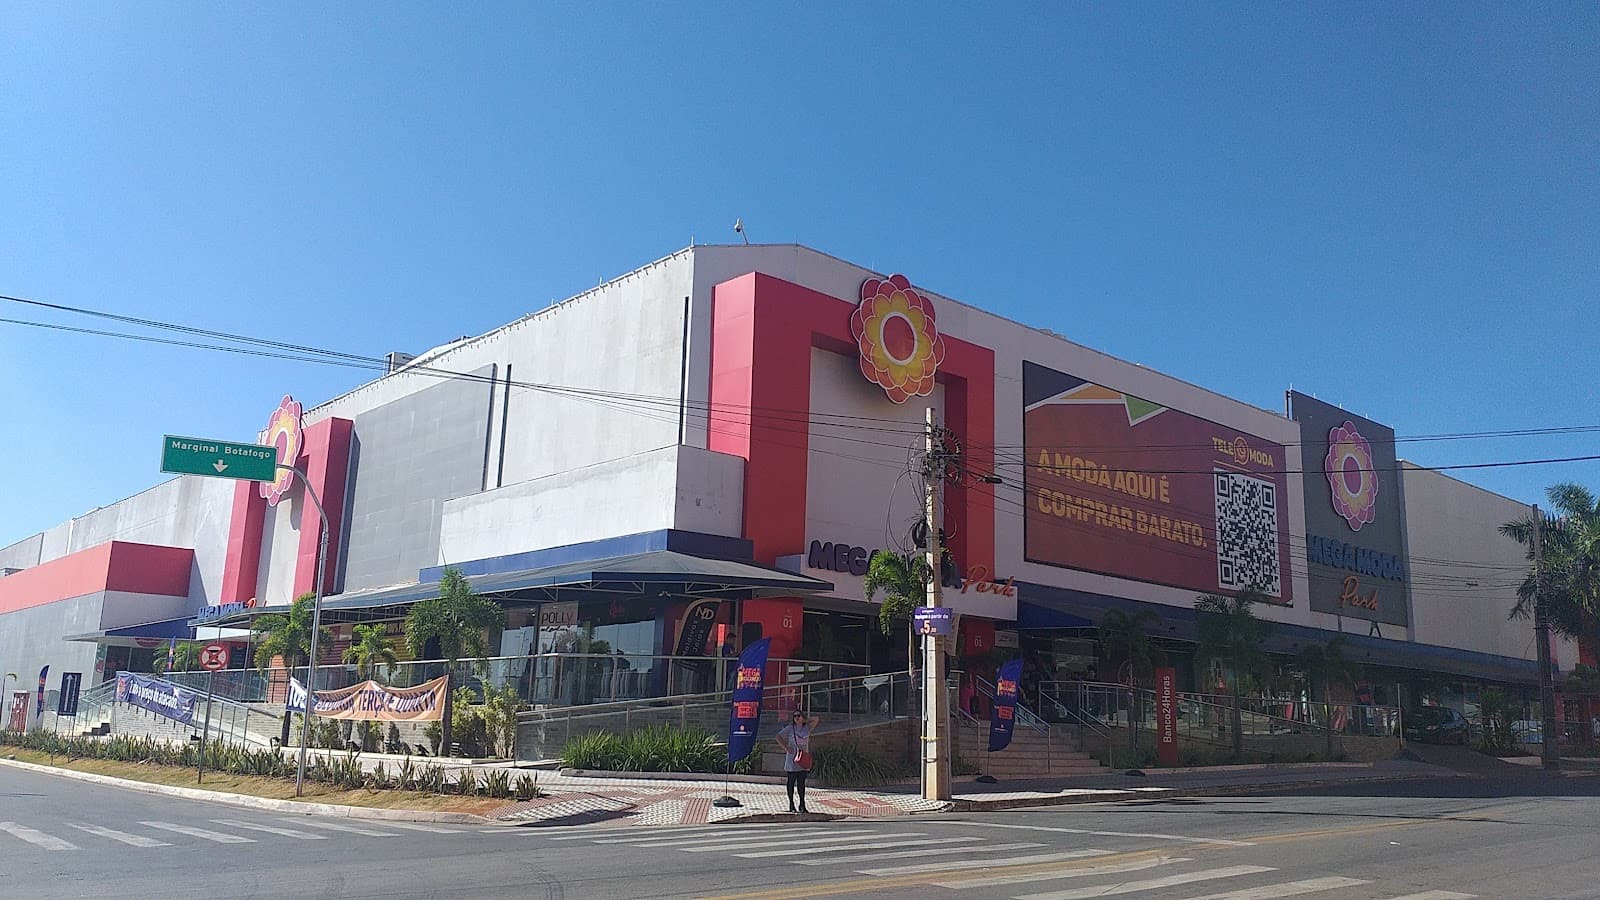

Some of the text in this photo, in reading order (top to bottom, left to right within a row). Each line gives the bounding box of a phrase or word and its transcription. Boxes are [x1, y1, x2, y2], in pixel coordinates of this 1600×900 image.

[172, 441, 271, 459] Marginal Botafogo
[1212, 436, 1274, 468] TELE MODA
[1037, 449, 1170, 504] A MODA AQUI É
[1037, 487, 1208, 548] COMPRAR BARATO.
[1310, 535, 1403, 582] MEGA MODA
[961, 565, 1015, 598] Park
[1342, 575, 1379, 610] Park
[541, 611, 573, 626] POLLY
[784, 618, 793, 628] 01
[1162, 676, 1172, 743] Banco24Horas
